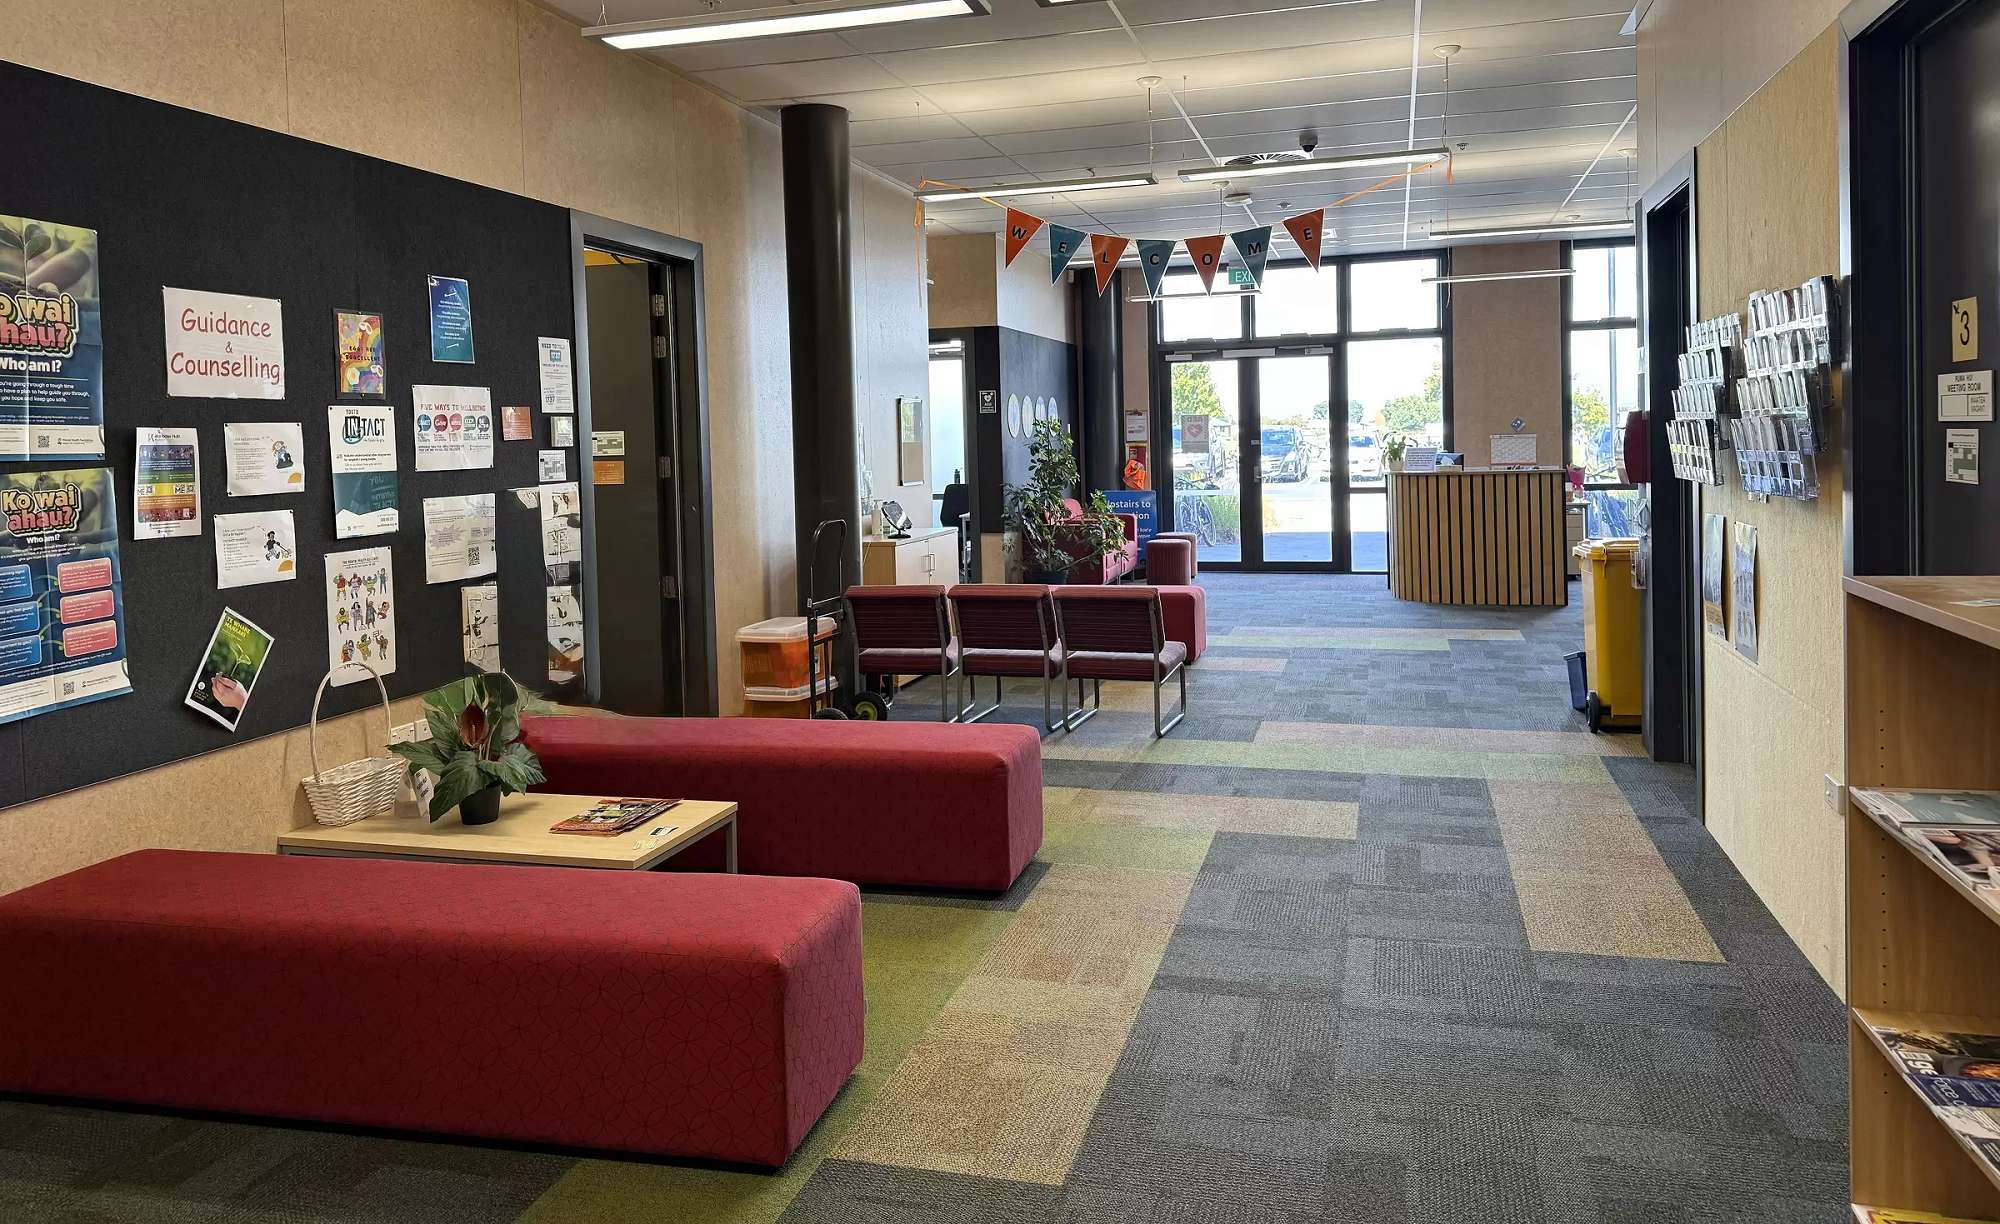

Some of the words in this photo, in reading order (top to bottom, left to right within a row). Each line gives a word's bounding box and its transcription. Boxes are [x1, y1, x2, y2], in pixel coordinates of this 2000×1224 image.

[1235, 271, 1252, 282] EXI
[17, 294, 71, 322] wai
[0, 315, 68, 349] hau?
[181, 308, 272, 337] Guidance
[1959, 310, 1970, 346] 3
[224, 341, 234, 354] &
[28, 361, 50, 373] am
[170, 352, 281, 385] Counselling
[2, 490, 31, 511] Ko
[35, 485, 75, 509] wai
[8, 506, 72, 530] ahau?
[26, 536, 43, 544] Who
